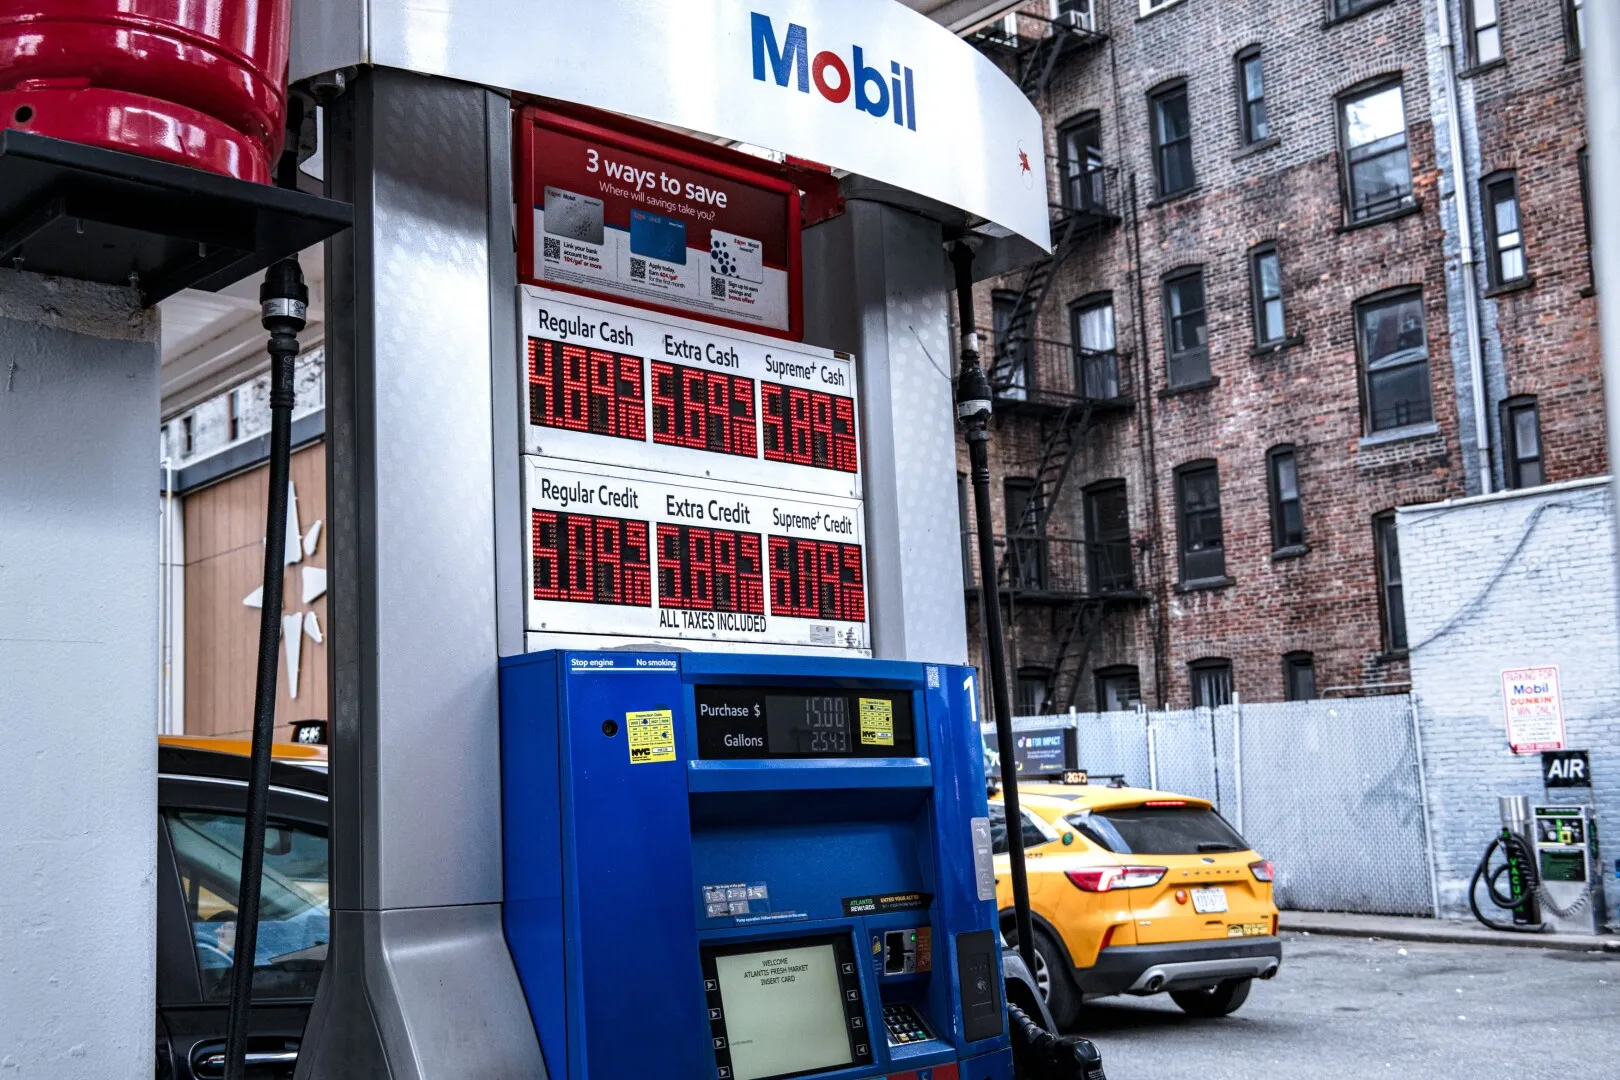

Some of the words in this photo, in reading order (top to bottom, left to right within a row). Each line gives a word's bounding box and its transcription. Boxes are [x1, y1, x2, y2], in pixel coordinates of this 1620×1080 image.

[751, 11, 917, 132] Mobil
[586, 148, 599, 173] 3
[603, 159, 656, 192] ways
[660, 171, 681, 196] to
[685, 182, 728, 209] save
[598, 180, 629, 199] Where
[630, 191, 645, 203] will
[646, 197, 677, 213] savings
[678, 203, 696, 217] take
[696, 209, 716, 222] you?
[563, 241, 575, 250] Link
[574, 245, 586, 253] your
[585, 247, 598, 255] bank
[563, 250, 583, 259] account
[582, 252, 589, 260] to
[588, 255, 600, 263] save
[589, 262, 603, 270] more
[648, 262, 662, 271] Apply
[648, 269, 660, 277] Earn
[727, 280, 738, 289] Sign
[737, 283, 744, 291] up
[728, 288, 744, 297] savings
[728, 294, 741, 302] bonus
[538, 308, 596, 340] Regular
[599, 320, 635, 347] Cash
[664, 334, 702, 362] Extra
[706, 343, 740, 369] Cash
[820, 366, 845, 387] Cash
[541, 478, 596, 507] Regular
[598, 485, 639, 509] Credit
[666, 494, 704, 519] Extra
[708, 500, 751, 525] Credit
[823, 514, 853, 535] Credit
[659, 609, 680, 629] ALL
[681, 610, 715, 630] TAXES
[717, 613, 767, 633] INCLUDED
[571, 658, 589, 668] Stop
[589, 659, 614, 668] engine
[636, 659, 647, 667] No
[647, 658, 677, 669] smoking
[1513, 682, 1550, 695] Mobil
[963, 675, 977, 722] 1
[700, 703, 749, 717] Purchase
[753, 703, 761, 718] $
[805, 697, 845, 728] 15.00
[724, 733, 764, 747] Gallons
[862, 730, 876, 739] NYC
[1032, 737, 1042, 747] FOR
[1042, 735, 1061, 746] IMPACT
[811, 731, 847, 752] 2.543
[631, 748, 651, 757] NYC
[1548, 758, 1585, 778] AIR
[728, 890, 733, 898] 2
[748, 888, 753, 897] 3
[729, 903, 735, 912] 5
[850, 898, 873, 906] ATLANTIS
[850, 903, 876, 913] REWARDS
[708, 905, 714, 913] 4
[761, 957, 789, 967] WELCOME
[743, 969, 770, 979] ATLANTIS
[770, 967, 788, 976] FRESH
[787, 964, 809, 973] MARKET
[760, 976, 780, 986] INSERT
[780, 975, 796, 983] CARD
